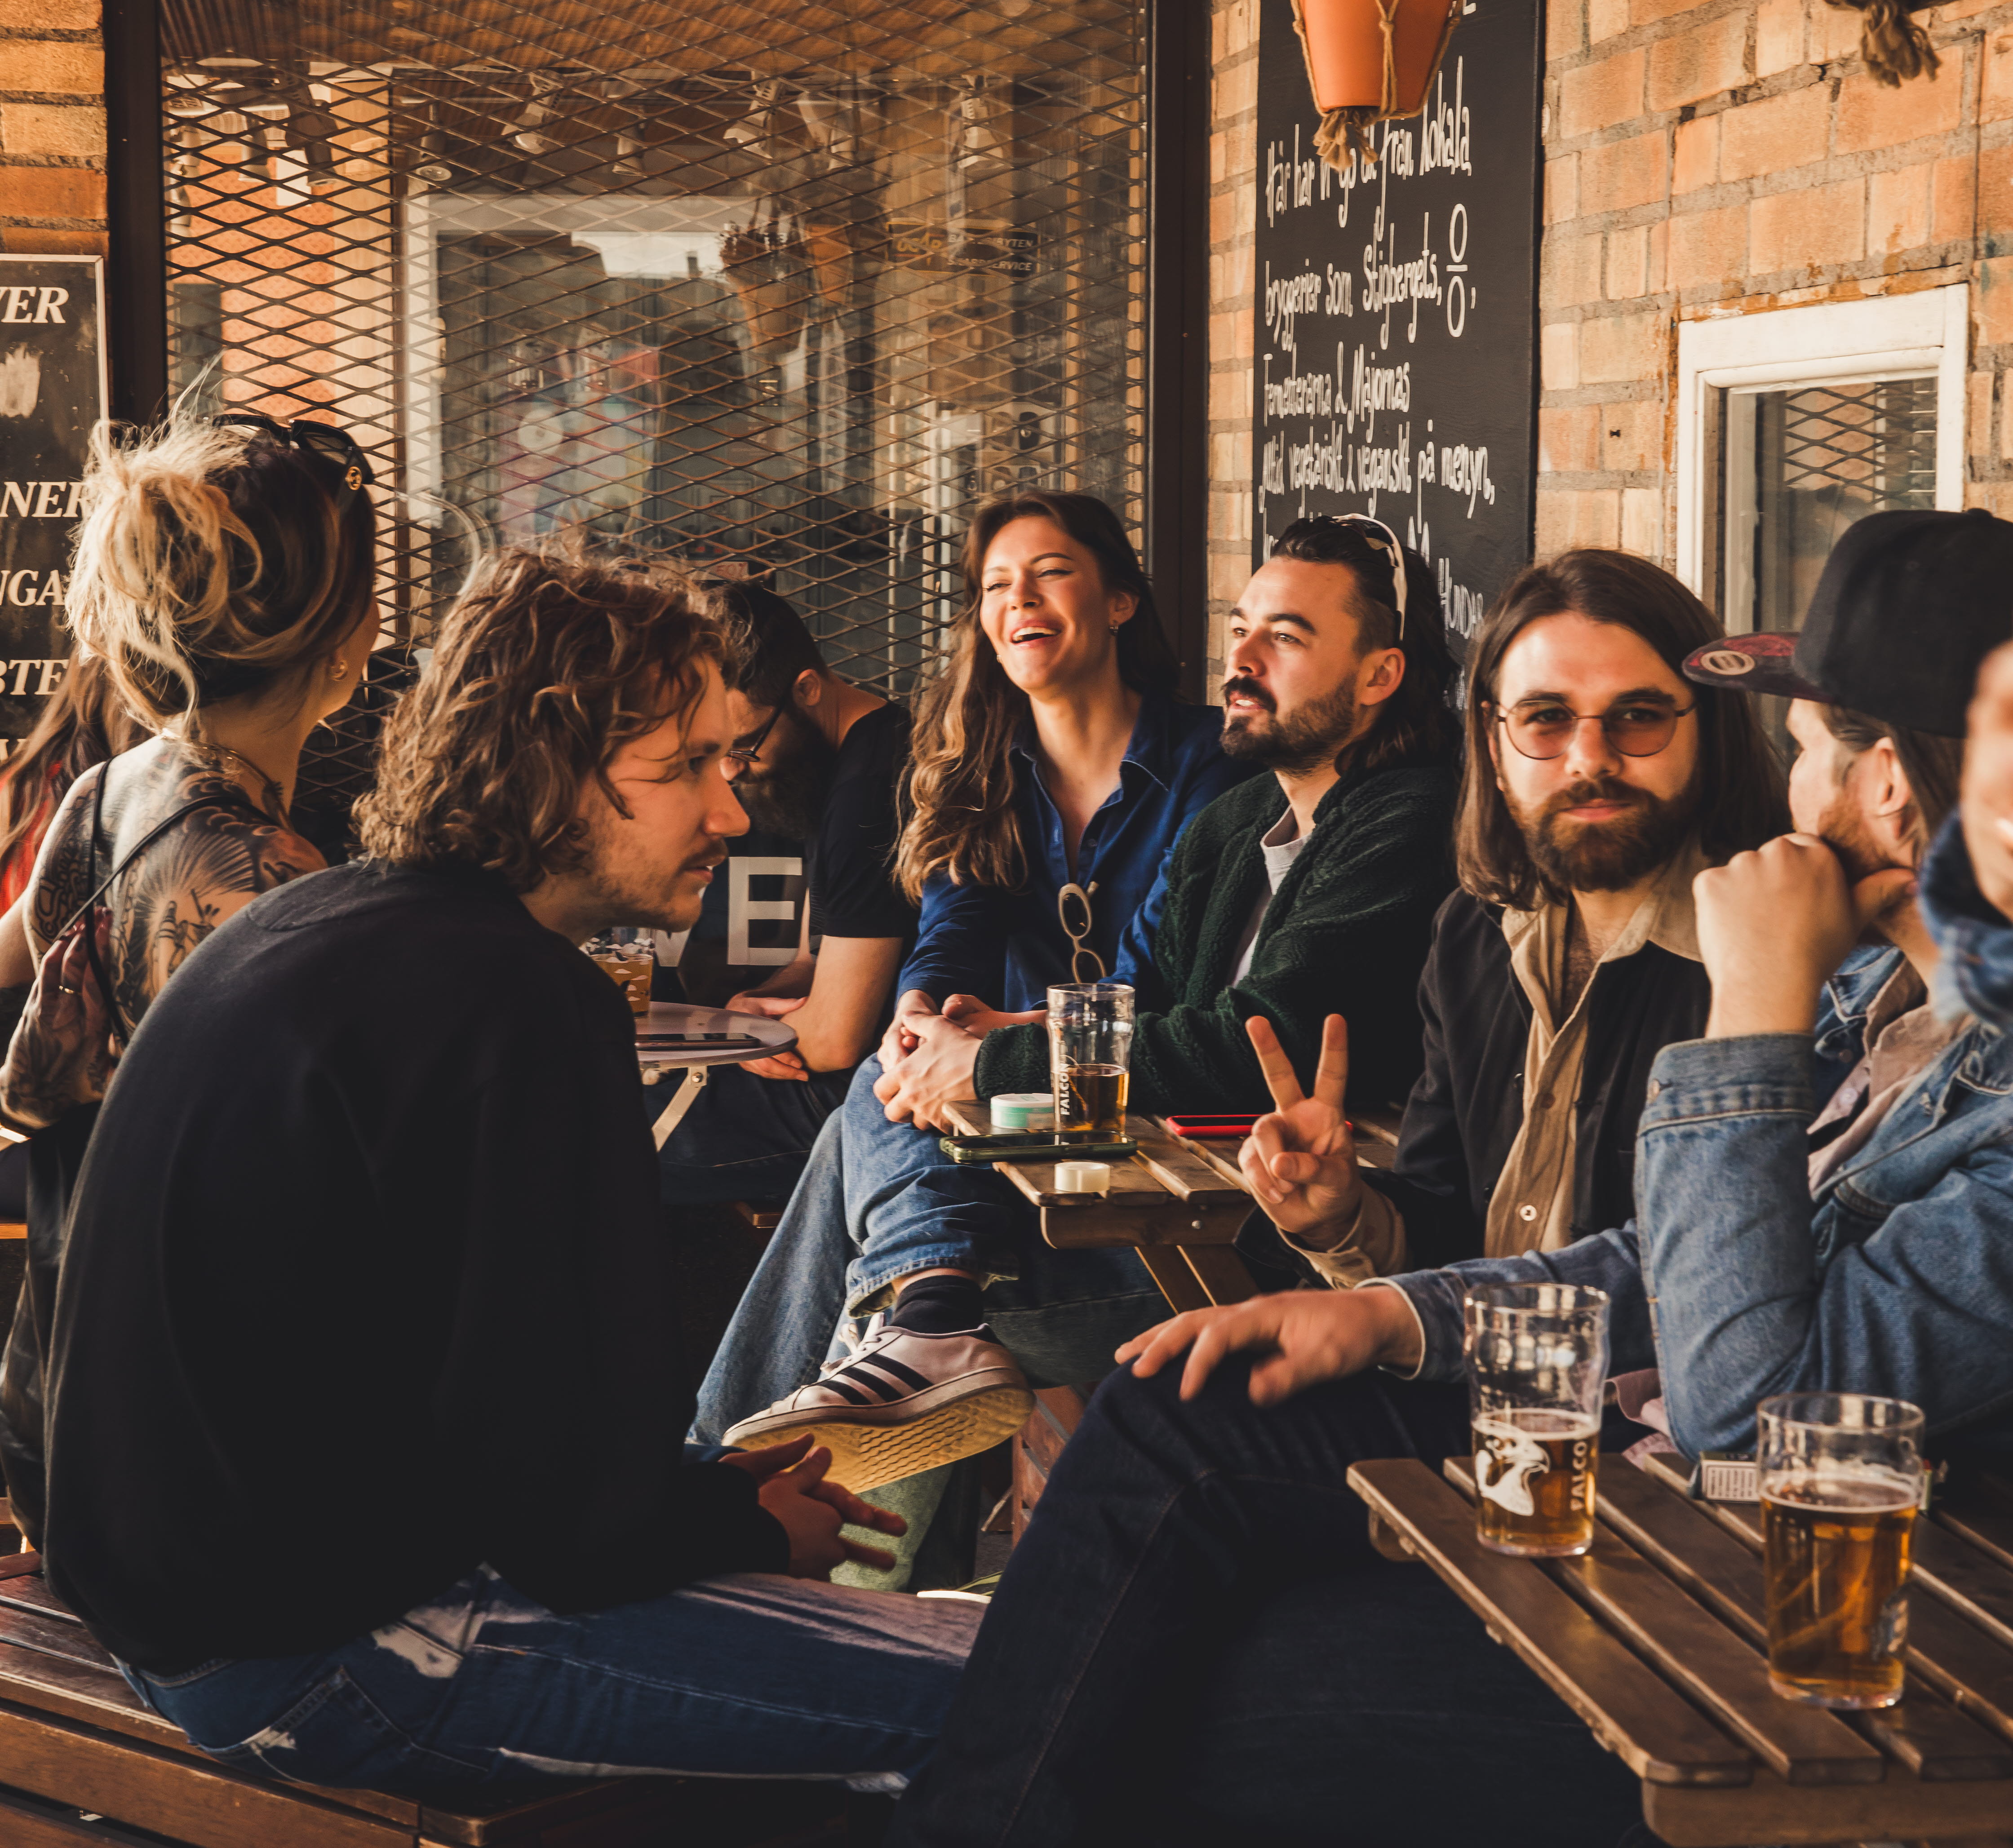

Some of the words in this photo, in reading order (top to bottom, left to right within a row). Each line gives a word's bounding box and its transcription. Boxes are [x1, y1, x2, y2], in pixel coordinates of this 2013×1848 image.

[1419, 55, 1472, 177] lokala
[1265, 258, 1321, 352] bryggerier
[1347, 344, 1410, 443] Majornas
[1357, 421, 1412, 519] veganskt
[1417, 419, 1436, 534] på
[1441, 443, 1495, 519] menyn,
